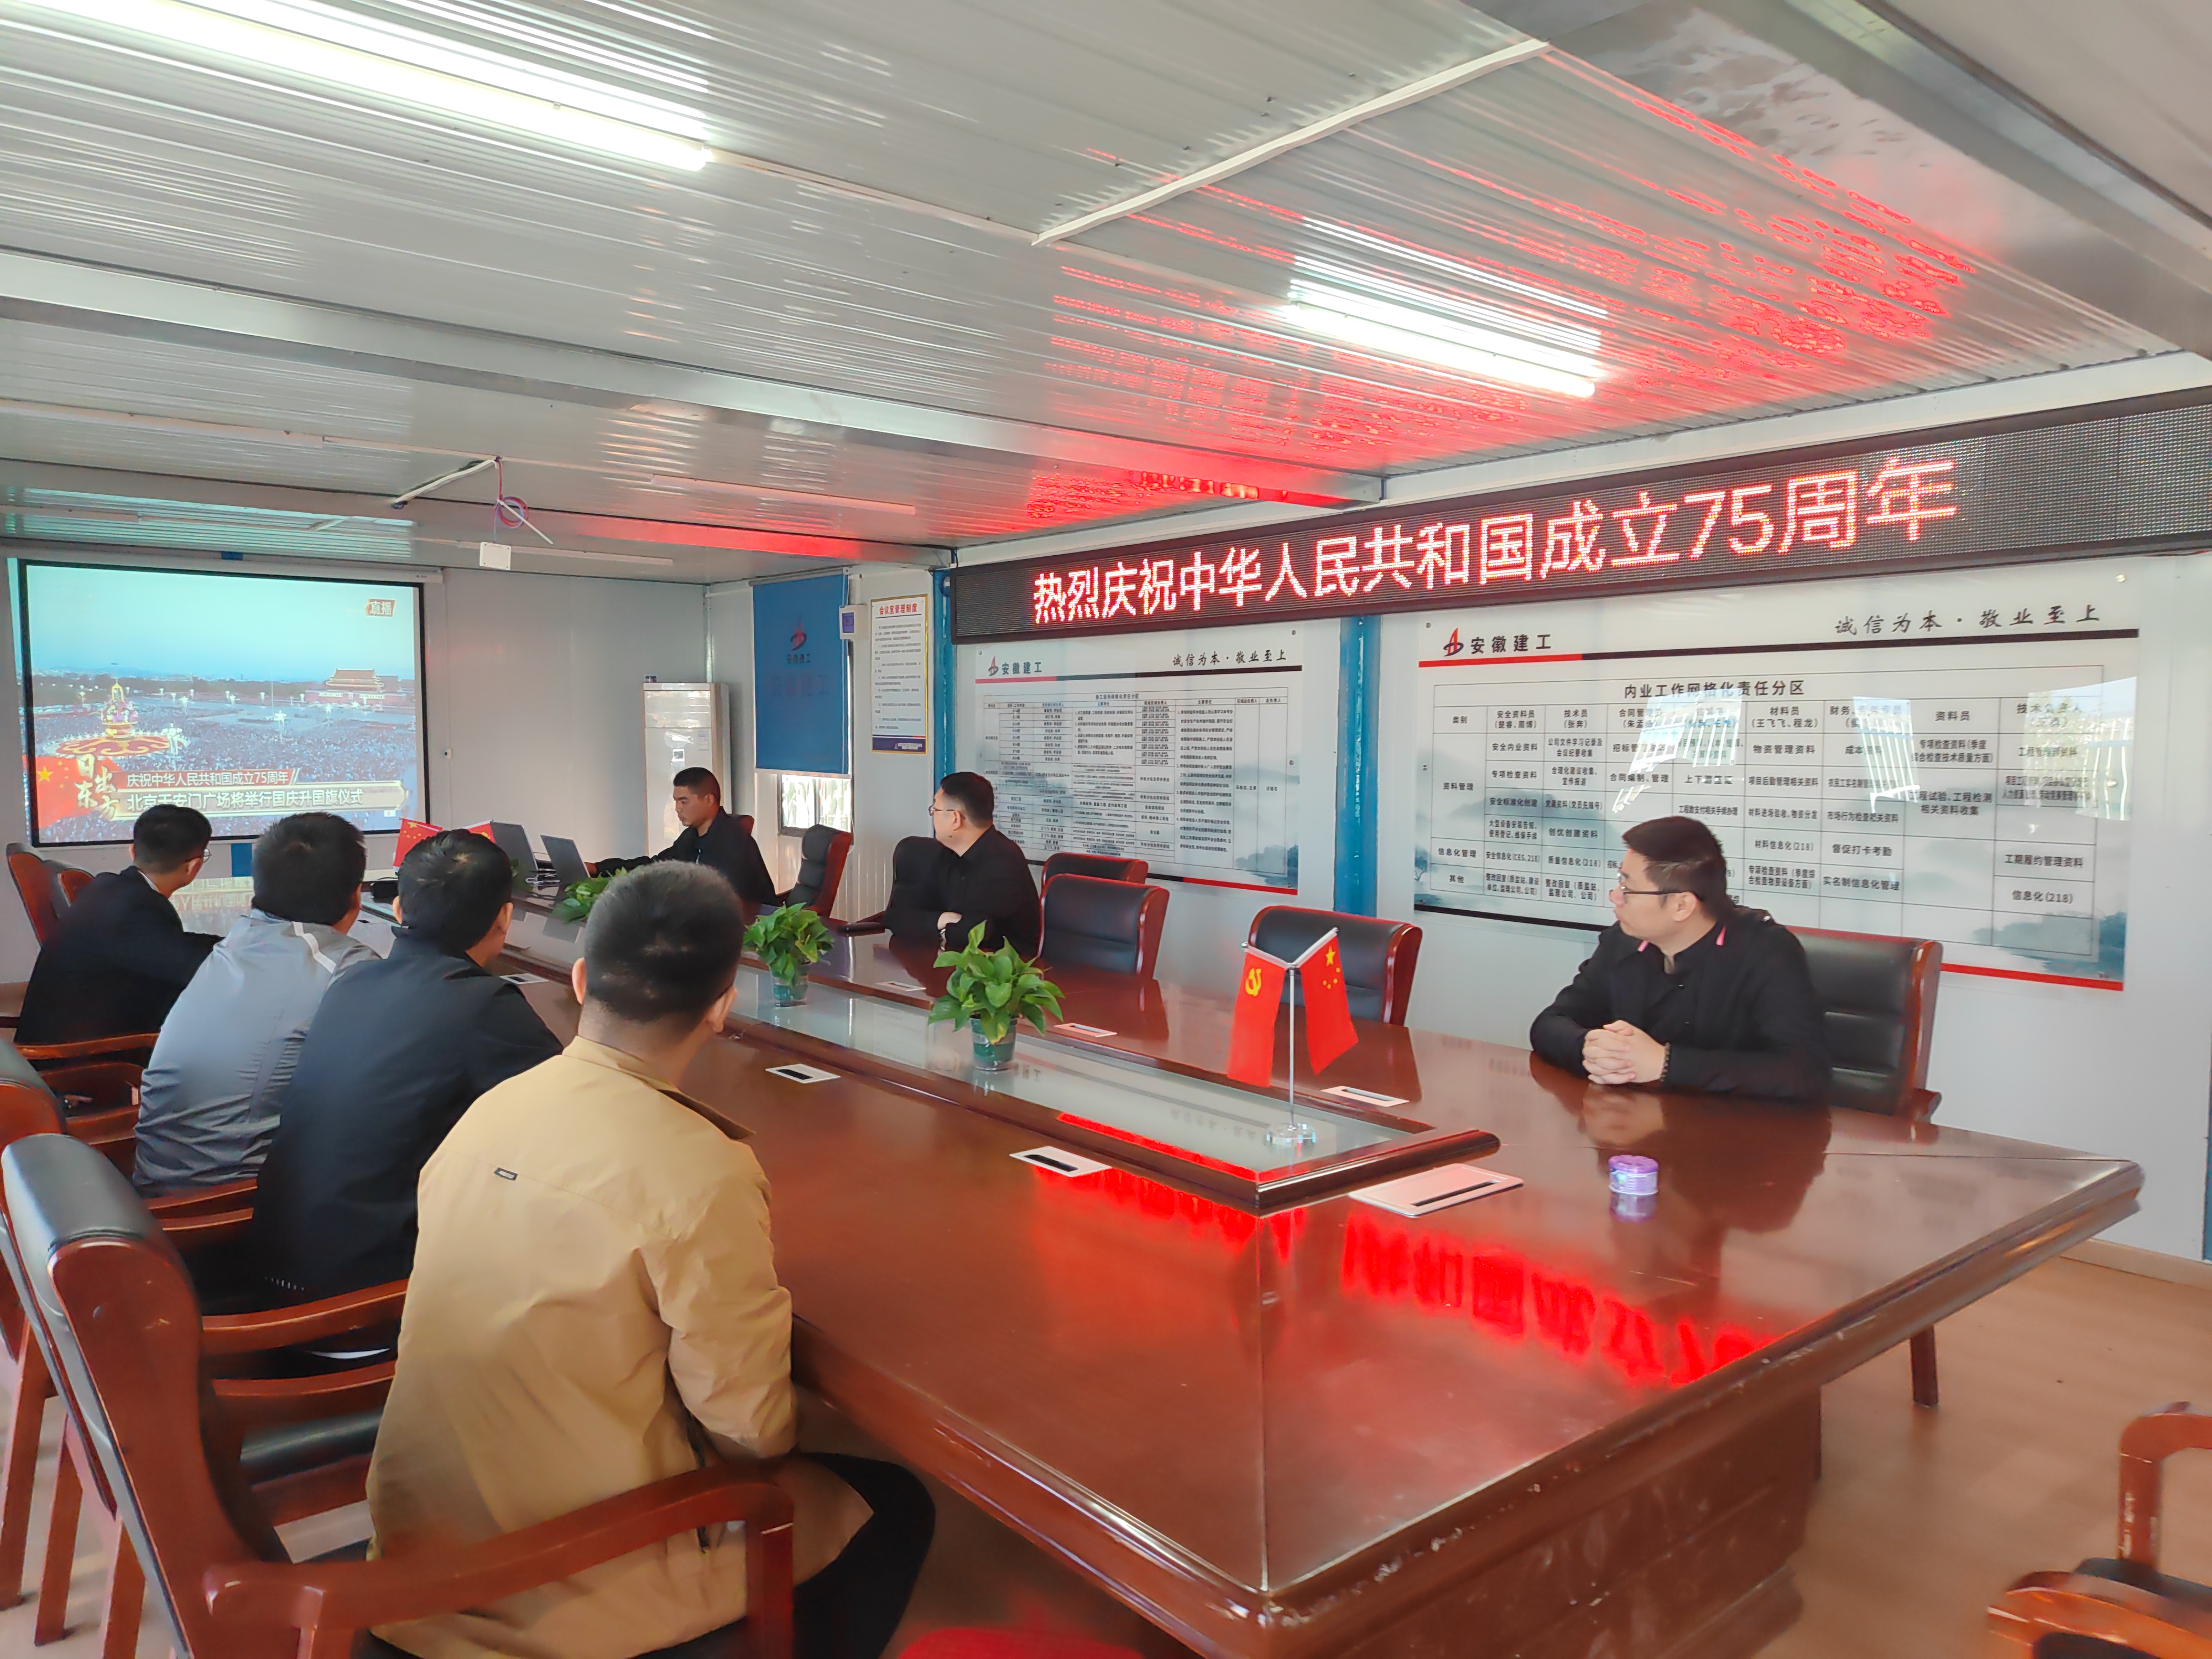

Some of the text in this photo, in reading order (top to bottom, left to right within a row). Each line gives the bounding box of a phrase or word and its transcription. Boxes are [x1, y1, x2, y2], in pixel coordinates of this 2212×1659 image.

[1032, 457, 1959, 624] 热烈庆祝中华人民共和国成立75周年
[371, 601, 393, 616] 直播
[1835, 604, 2102, 636] 诚信为本·敬业至上
[1470, 633, 1552, 655] 安徽建工
[1172, 649, 1287, 667] 诚信为本·敬业至上
[1002, 662, 1042, 675] 安徽建工
[1624, 680, 1805, 699] 内业工作网格化责任分区
[1497, 710, 1535, 718] 安全资料员
[1563, 709, 1588, 718] 技术员
[1770, 706, 1799, 716] 材料员
[1936, 711, 1970, 721] 资料员
[1452, 716, 1468, 724] 类别
[1492, 743, 1538, 752] 安全内业资料
[1753, 744, 1815, 754] 物资管理资料
[127, 770, 289, 787] 庆祝中华人民共和国成立75周年
[1491, 770, 1537, 779] 专项检查资料
[1610, 773, 1669, 783] 合同编制、管理
[1443, 782, 1474, 791] 资料管理
[1489, 797, 1538, 807] 安全标准化创建
[1921, 804, 1980, 816] 相关资料收集
[1549, 827, 1598, 839] 创优创建资料
[1755, 839, 1814, 852] 材料信息化(218)
[1832, 844, 1892, 857] 督促打卡考勤
[1438, 848, 1477, 858] 信息化管理
[1548, 855, 1601, 868] 质量信息化(218)
[1449, 874, 1464, 884] 其他
[1823, 876, 1900, 891] 实名制信息化管理
[2012, 889, 2074, 904] 信息化(218)
